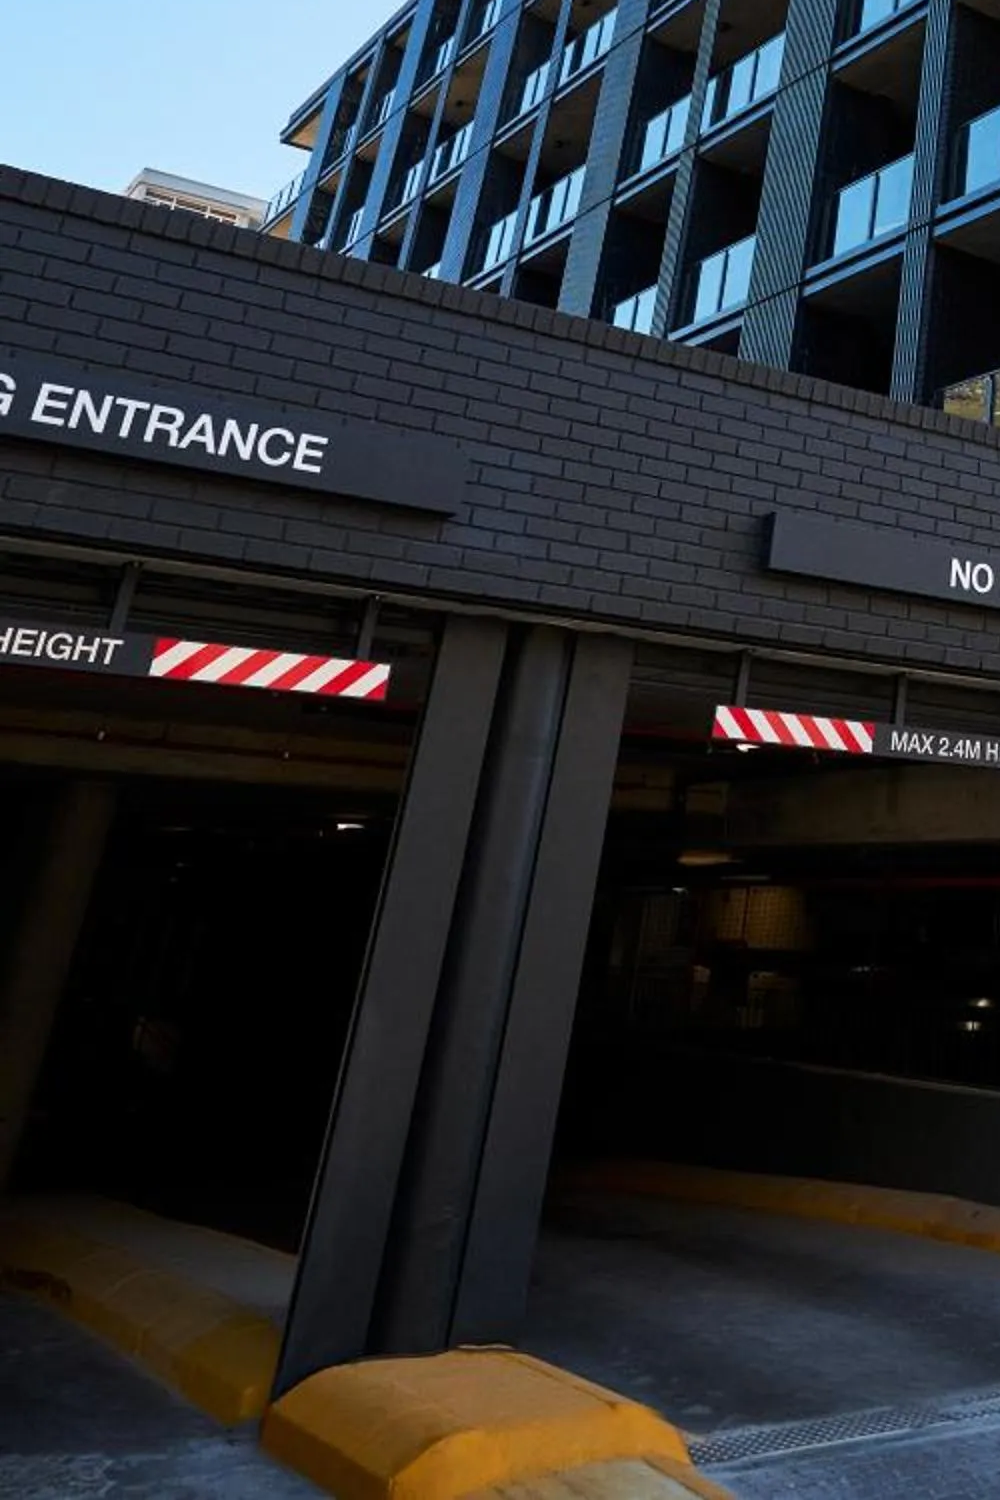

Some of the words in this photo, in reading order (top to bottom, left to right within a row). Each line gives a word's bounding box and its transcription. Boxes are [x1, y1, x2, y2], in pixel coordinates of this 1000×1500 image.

[31, 383, 329, 473] ENTRANCE
[949, 557, 994, 593] NO
[890, 731, 935, 755] MAX
[938, 737, 981, 759] 2.4M
